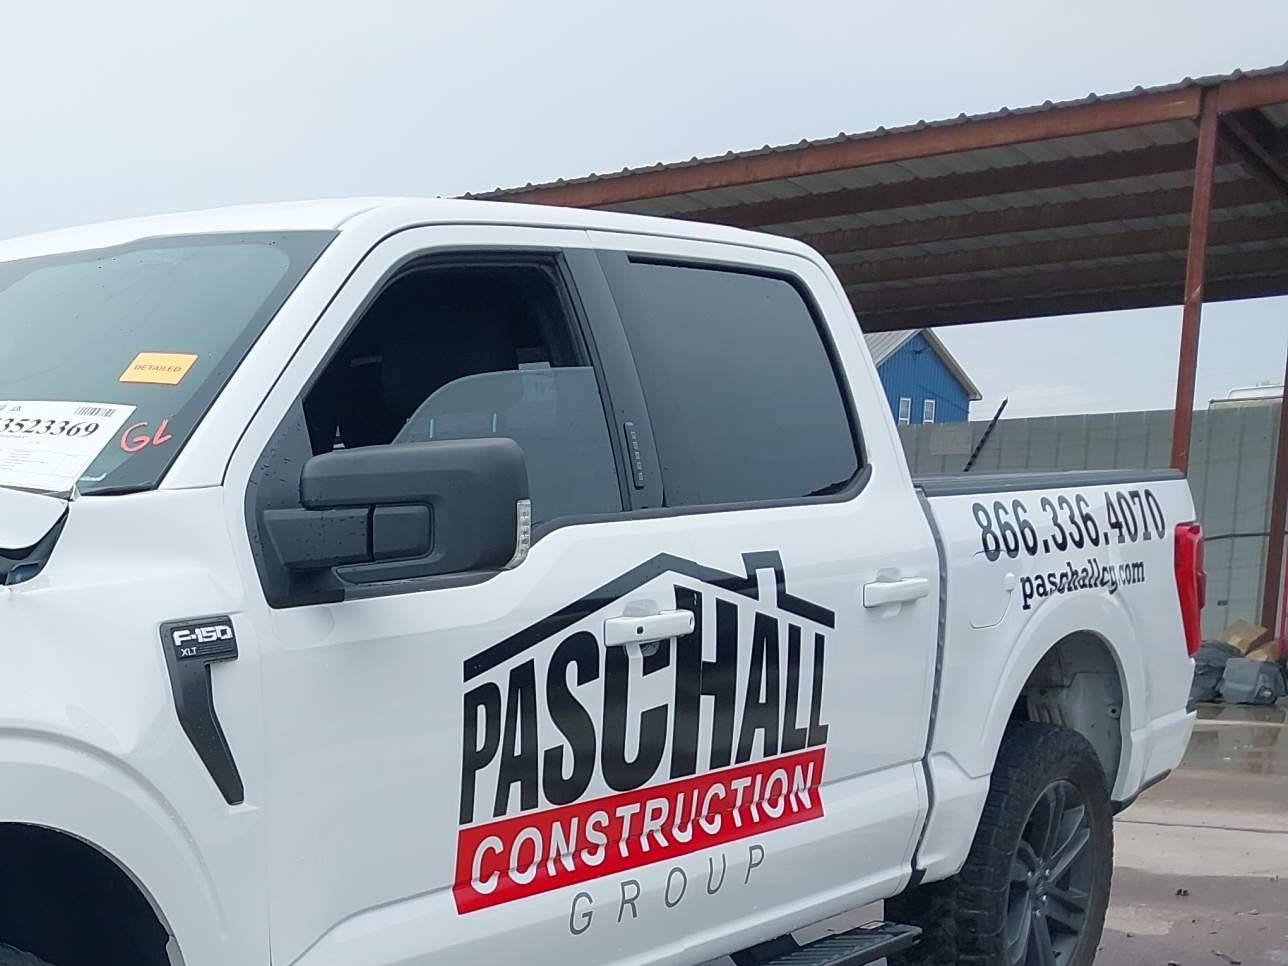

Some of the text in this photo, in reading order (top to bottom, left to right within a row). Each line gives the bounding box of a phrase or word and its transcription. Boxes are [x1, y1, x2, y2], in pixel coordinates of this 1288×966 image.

[133, 363, 183, 373] DETAILED
[972, 488, 1167, 562] 866.336.4070
[173, 625, 234, 647] F-150
[181, 646, 198, 657] XLT
[458, 584, 830, 825] PASCHALL
[469, 761, 817, 895] CONSTRUCTION
[568, 843, 767, 936] GROUP
